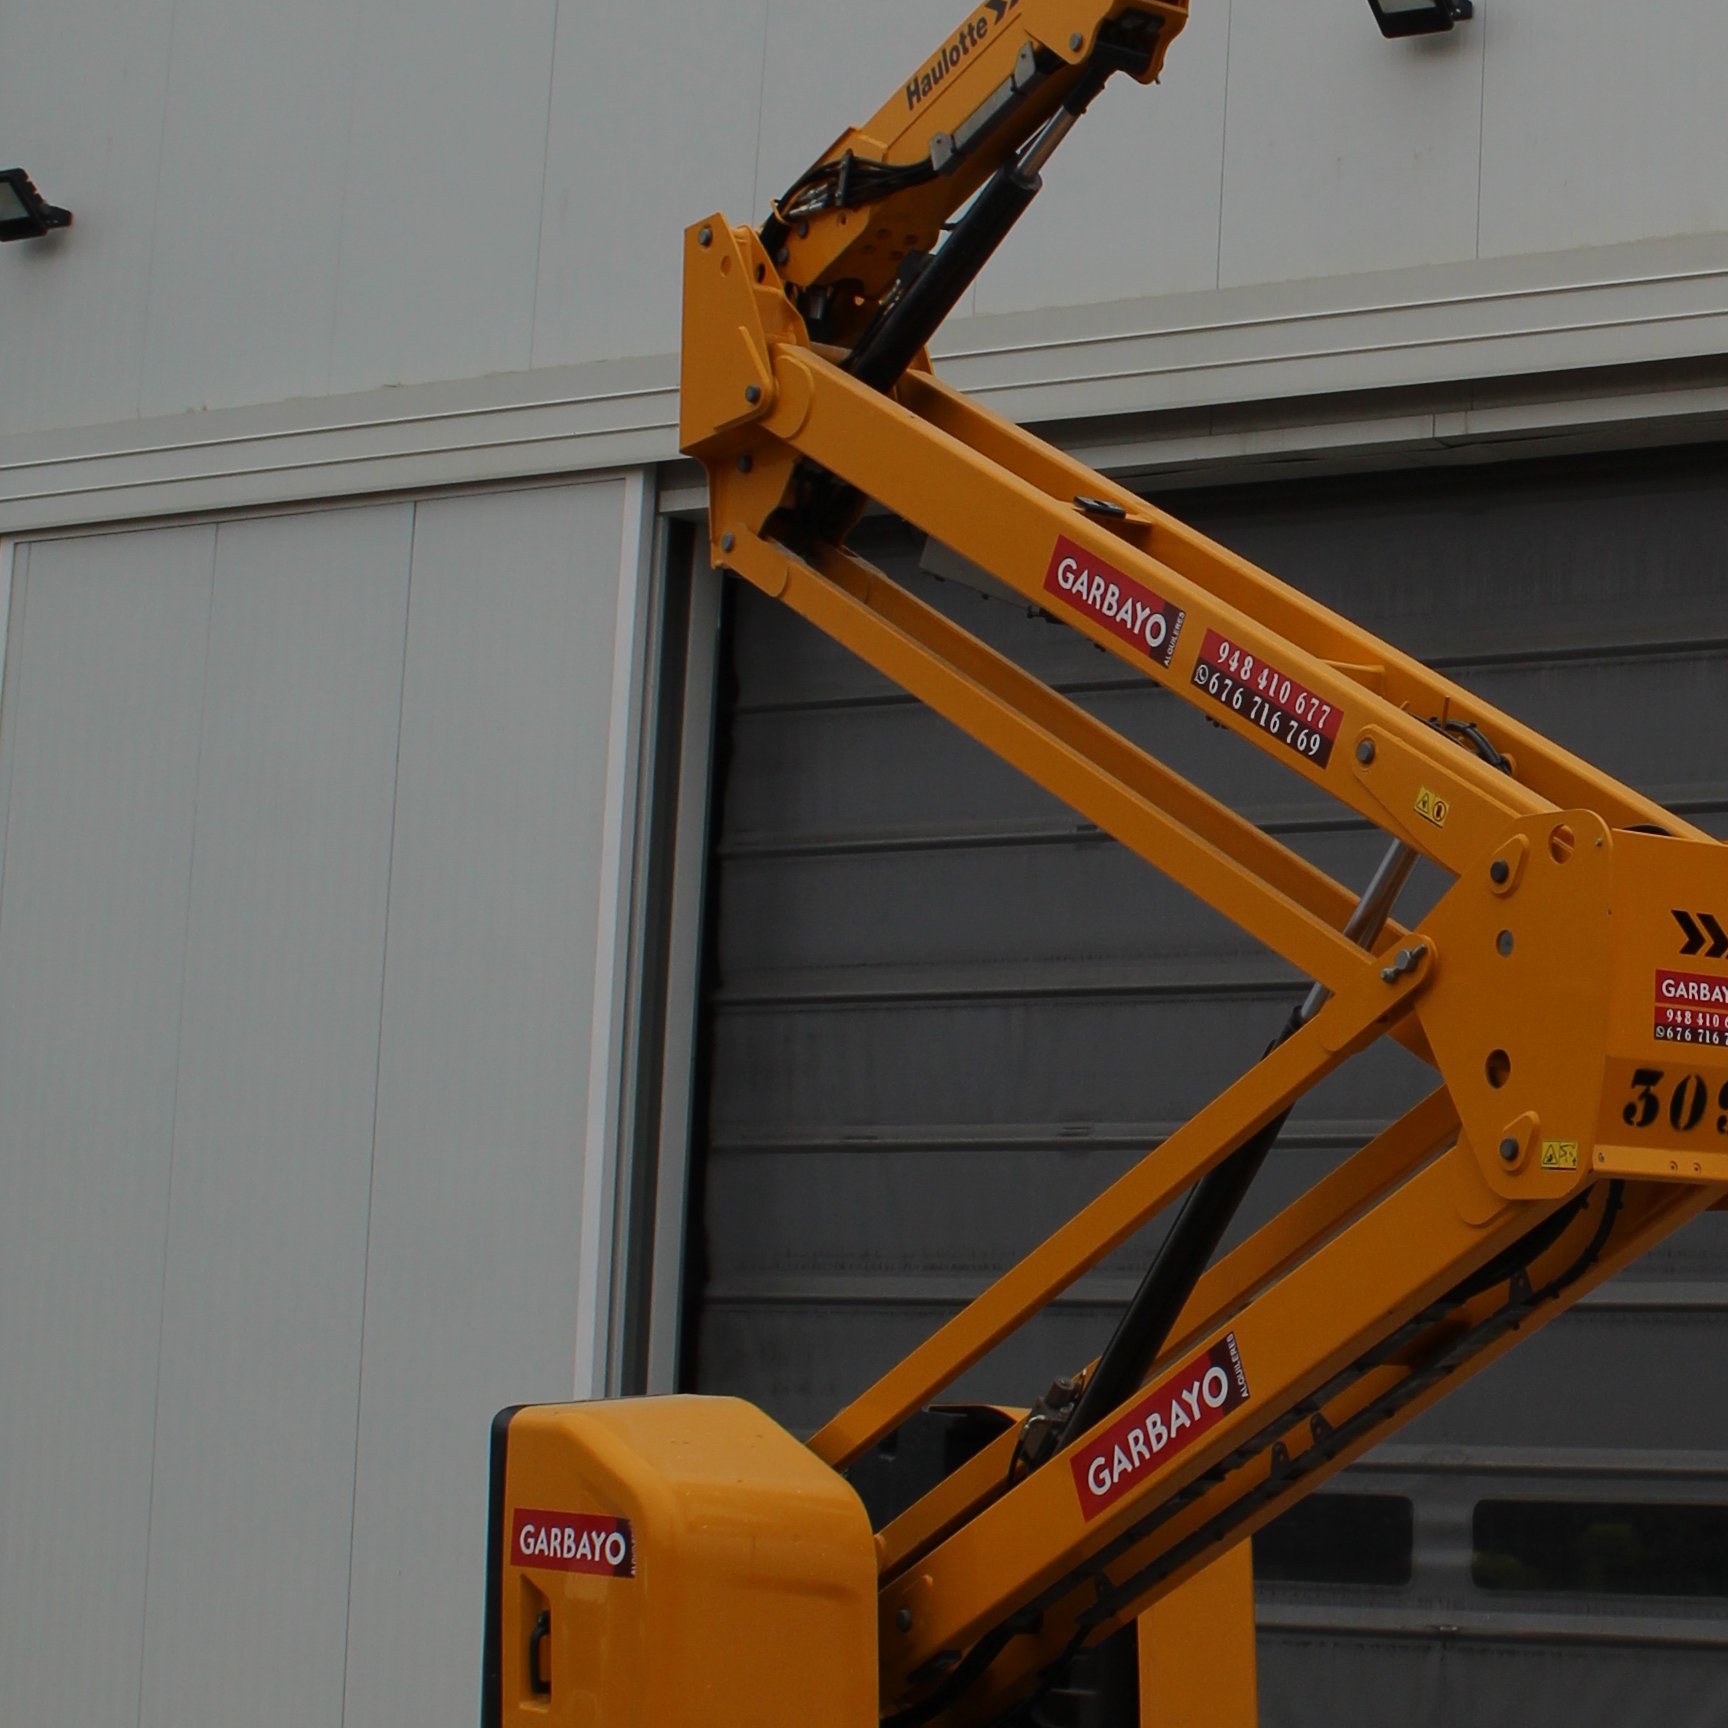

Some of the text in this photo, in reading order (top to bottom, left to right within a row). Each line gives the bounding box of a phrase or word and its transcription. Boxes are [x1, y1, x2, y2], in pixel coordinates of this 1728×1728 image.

[905, 14, 989, 110] Haulotte
[1057, 557, 1167, 648] GARBAYO
[1208, 672, 1322, 757] 676 716 769
[1217, 641, 1332, 729] 948 410 677
[1666, 1008, 1692, 1025] 948
[1696, 1012, 1720, 1028] 410
[1666, 1027, 1692, 1042] 676
[1697, 1029, 1720, 1044] 716
[1087, 1366, 1229, 1496] GARBAYO
[520, 1524, 626, 1565] GARBAYO
